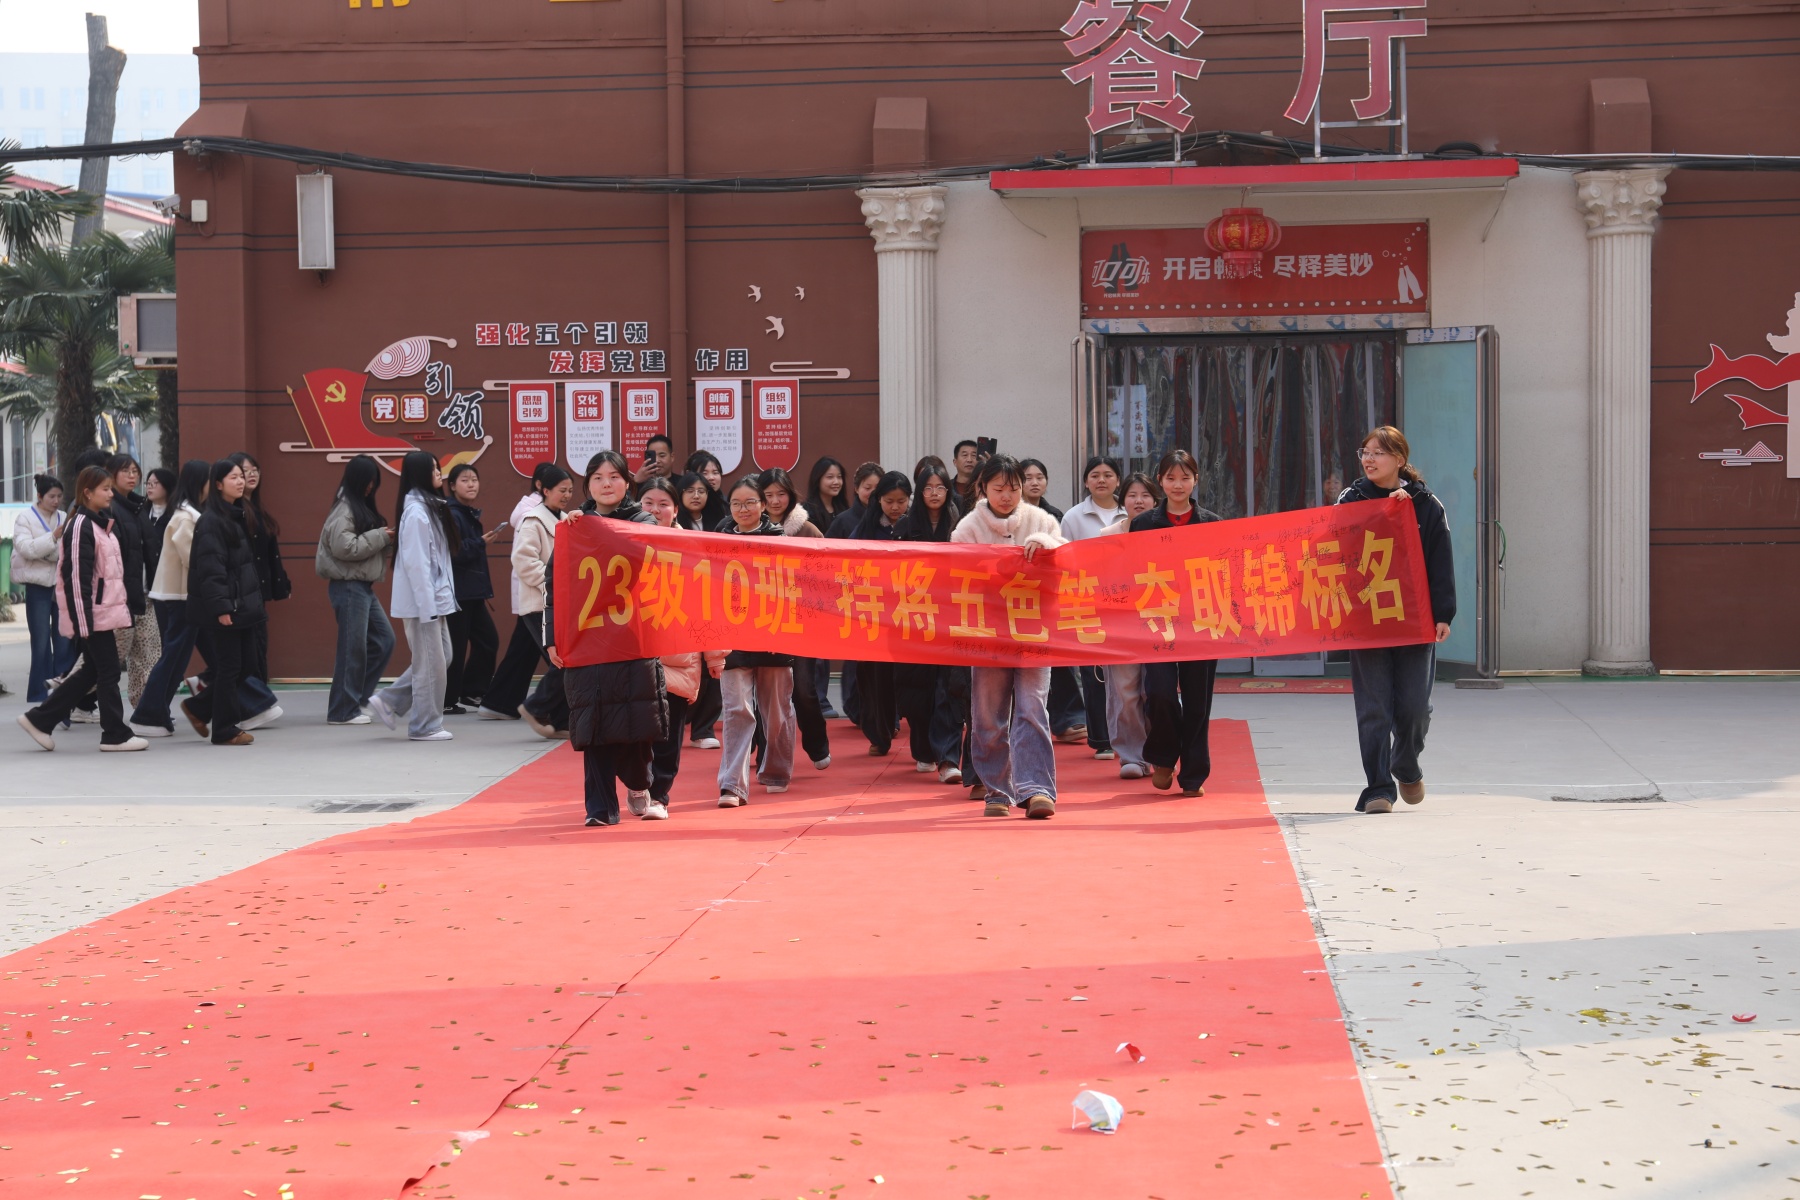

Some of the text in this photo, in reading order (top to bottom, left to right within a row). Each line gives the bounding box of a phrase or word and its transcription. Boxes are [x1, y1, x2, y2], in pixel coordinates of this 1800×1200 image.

[1060, 0, 1428, 135] 餐厅
[1273, 252, 1374, 278] 尽释美妙
[475, 321, 648, 346] 强化五个引领
[549, 348, 749, 374] 发挥党建 作用
[424, 361, 485, 440] 引领
[522, 395, 542, 406] 思想
[577, 394, 598, 406] 文化
[633, 394, 654, 405] 意识
[708, 392, 730, 404] 创新
[765, 392, 786, 402] 组织
[373, 397, 426, 420] 党建
[522, 407, 543, 418] 引领
[577, 406, 599, 418] 引领
[633, 406, 655, 417] 引领
[708, 405, 730, 416] 引领
[766, 404, 787, 415] 引领
[577, 545, 805, 636] 23级10班
[838, 557, 1107, 644] 持将五色笔
[1134, 529, 1406, 643] 夺取锦标名
